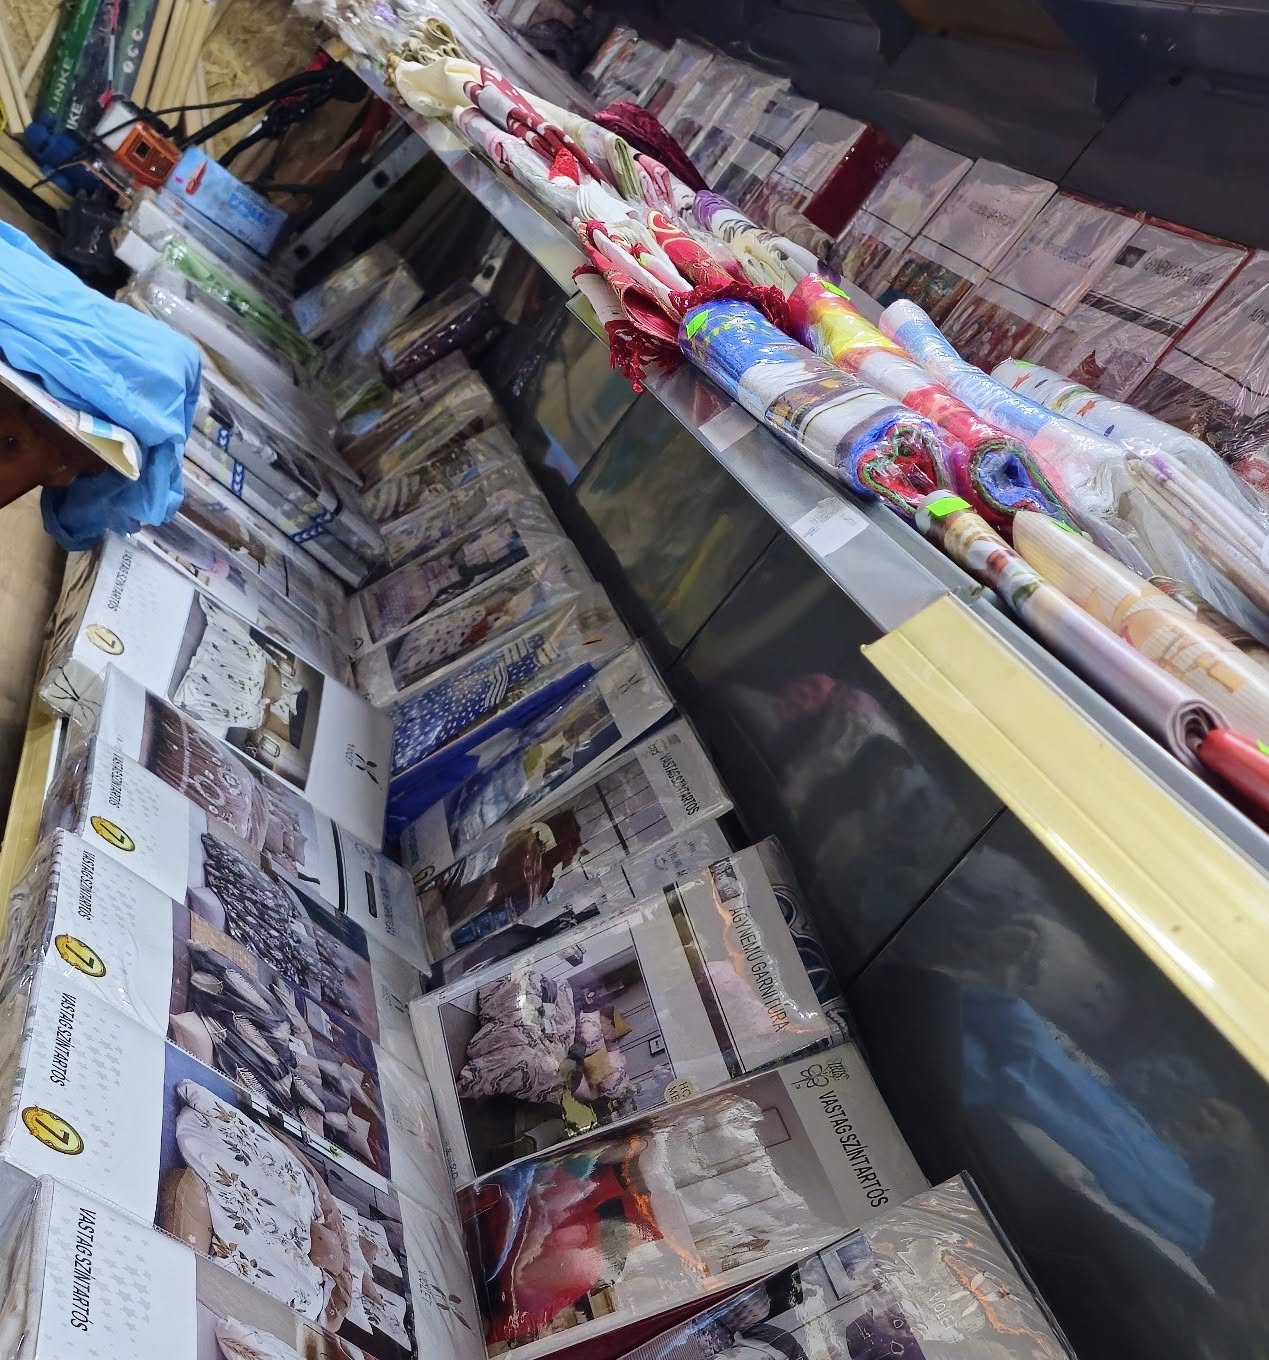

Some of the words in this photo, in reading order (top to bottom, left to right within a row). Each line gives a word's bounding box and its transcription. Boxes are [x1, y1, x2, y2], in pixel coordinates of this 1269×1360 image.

[65, 943, 95, 969] 7
[58, 992, 77, 1030] VASTAG
[35, 1117, 70, 1145] 7
[819, 1090, 852, 1134] VASTAG
[840, 1134, 888, 1207] SZÍNTARTÓS
[76, 1208, 97, 1256] VASTAG
[70, 1255, 95, 1331] SZÍNTARTÓS
